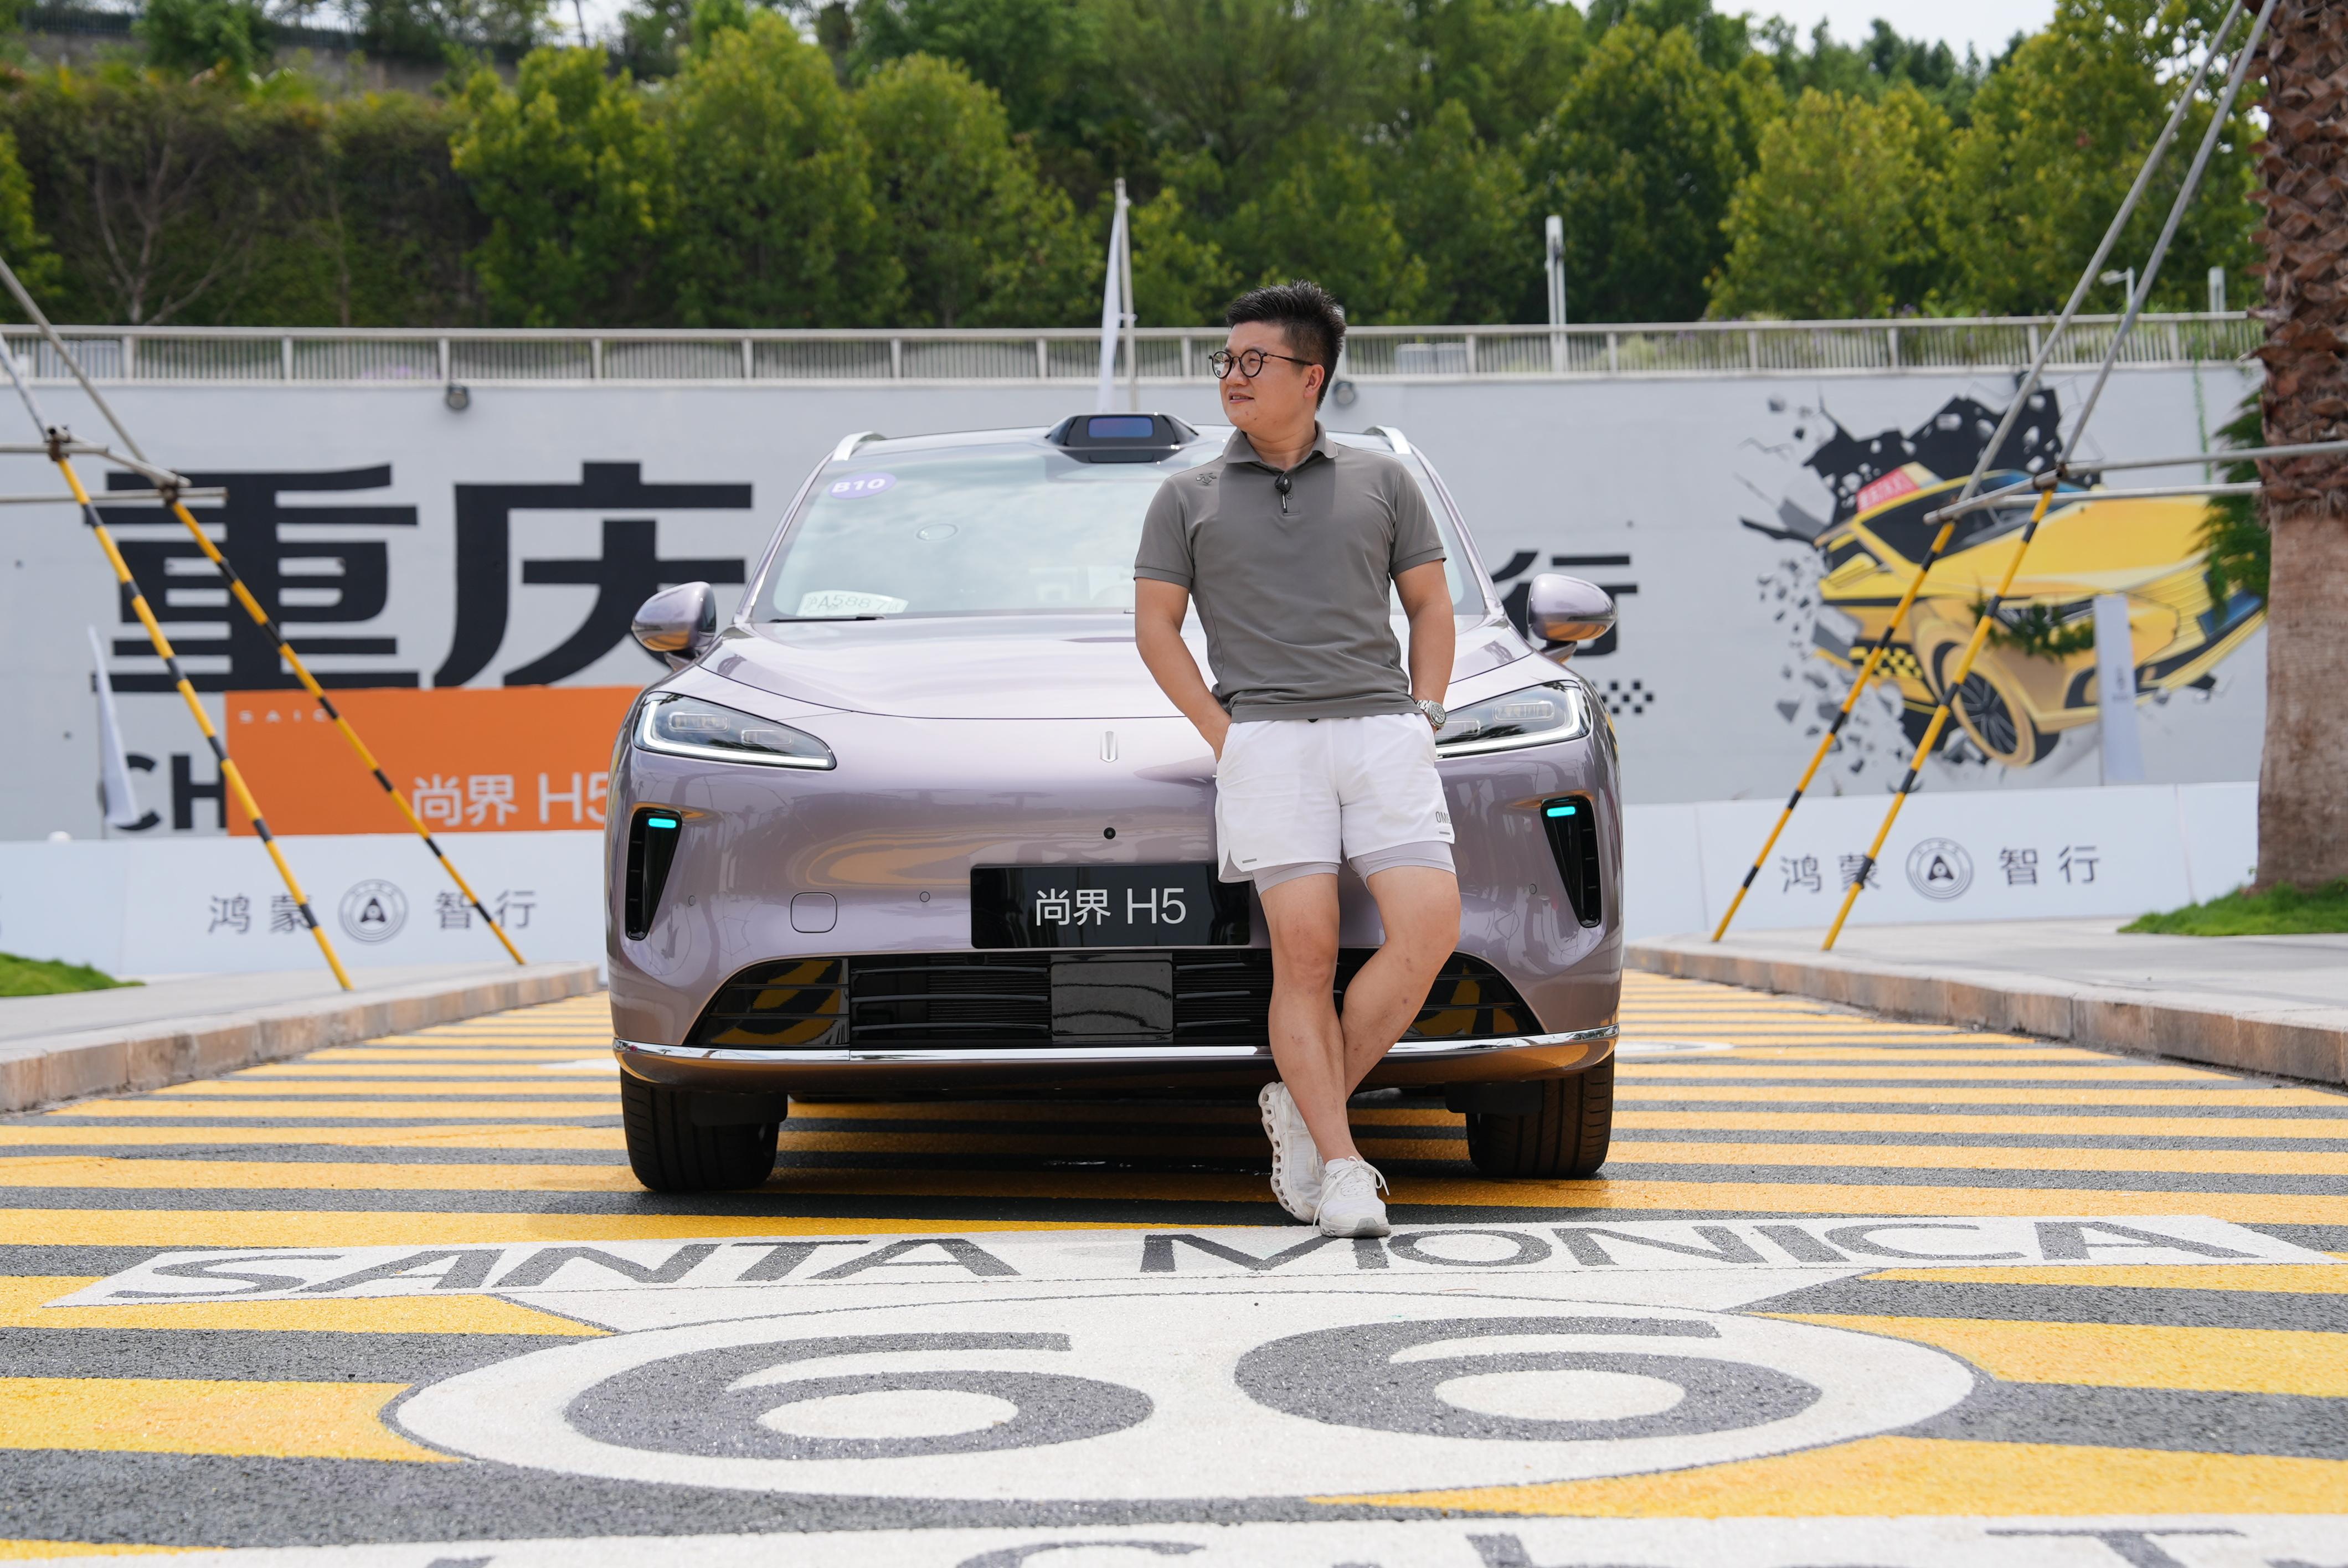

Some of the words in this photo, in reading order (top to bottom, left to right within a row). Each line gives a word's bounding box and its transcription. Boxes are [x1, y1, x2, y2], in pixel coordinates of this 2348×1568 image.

[831, 478, 886, 493] B10
[84, 461, 753, 692] 重庆
[239, 708, 328, 724] SAIC
[412, 774, 518, 827] 尚界
[538, 772, 609, 824] H5
[1779, 851, 1881, 894] 鸿蒙
[1999, 845, 2100, 887] 智行
[207, 892, 313, 935] 鸿蒙
[434, 889, 538, 930] 智行
[1036, 888, 1111, 926] 尚界
[1126, 887, 1187, 925] H5
[109, 1238, 1023, 1299] SANTA
[1140, 1220, 2268, 1273] MONICA
[564, 1316, 1825, 1463] 66
